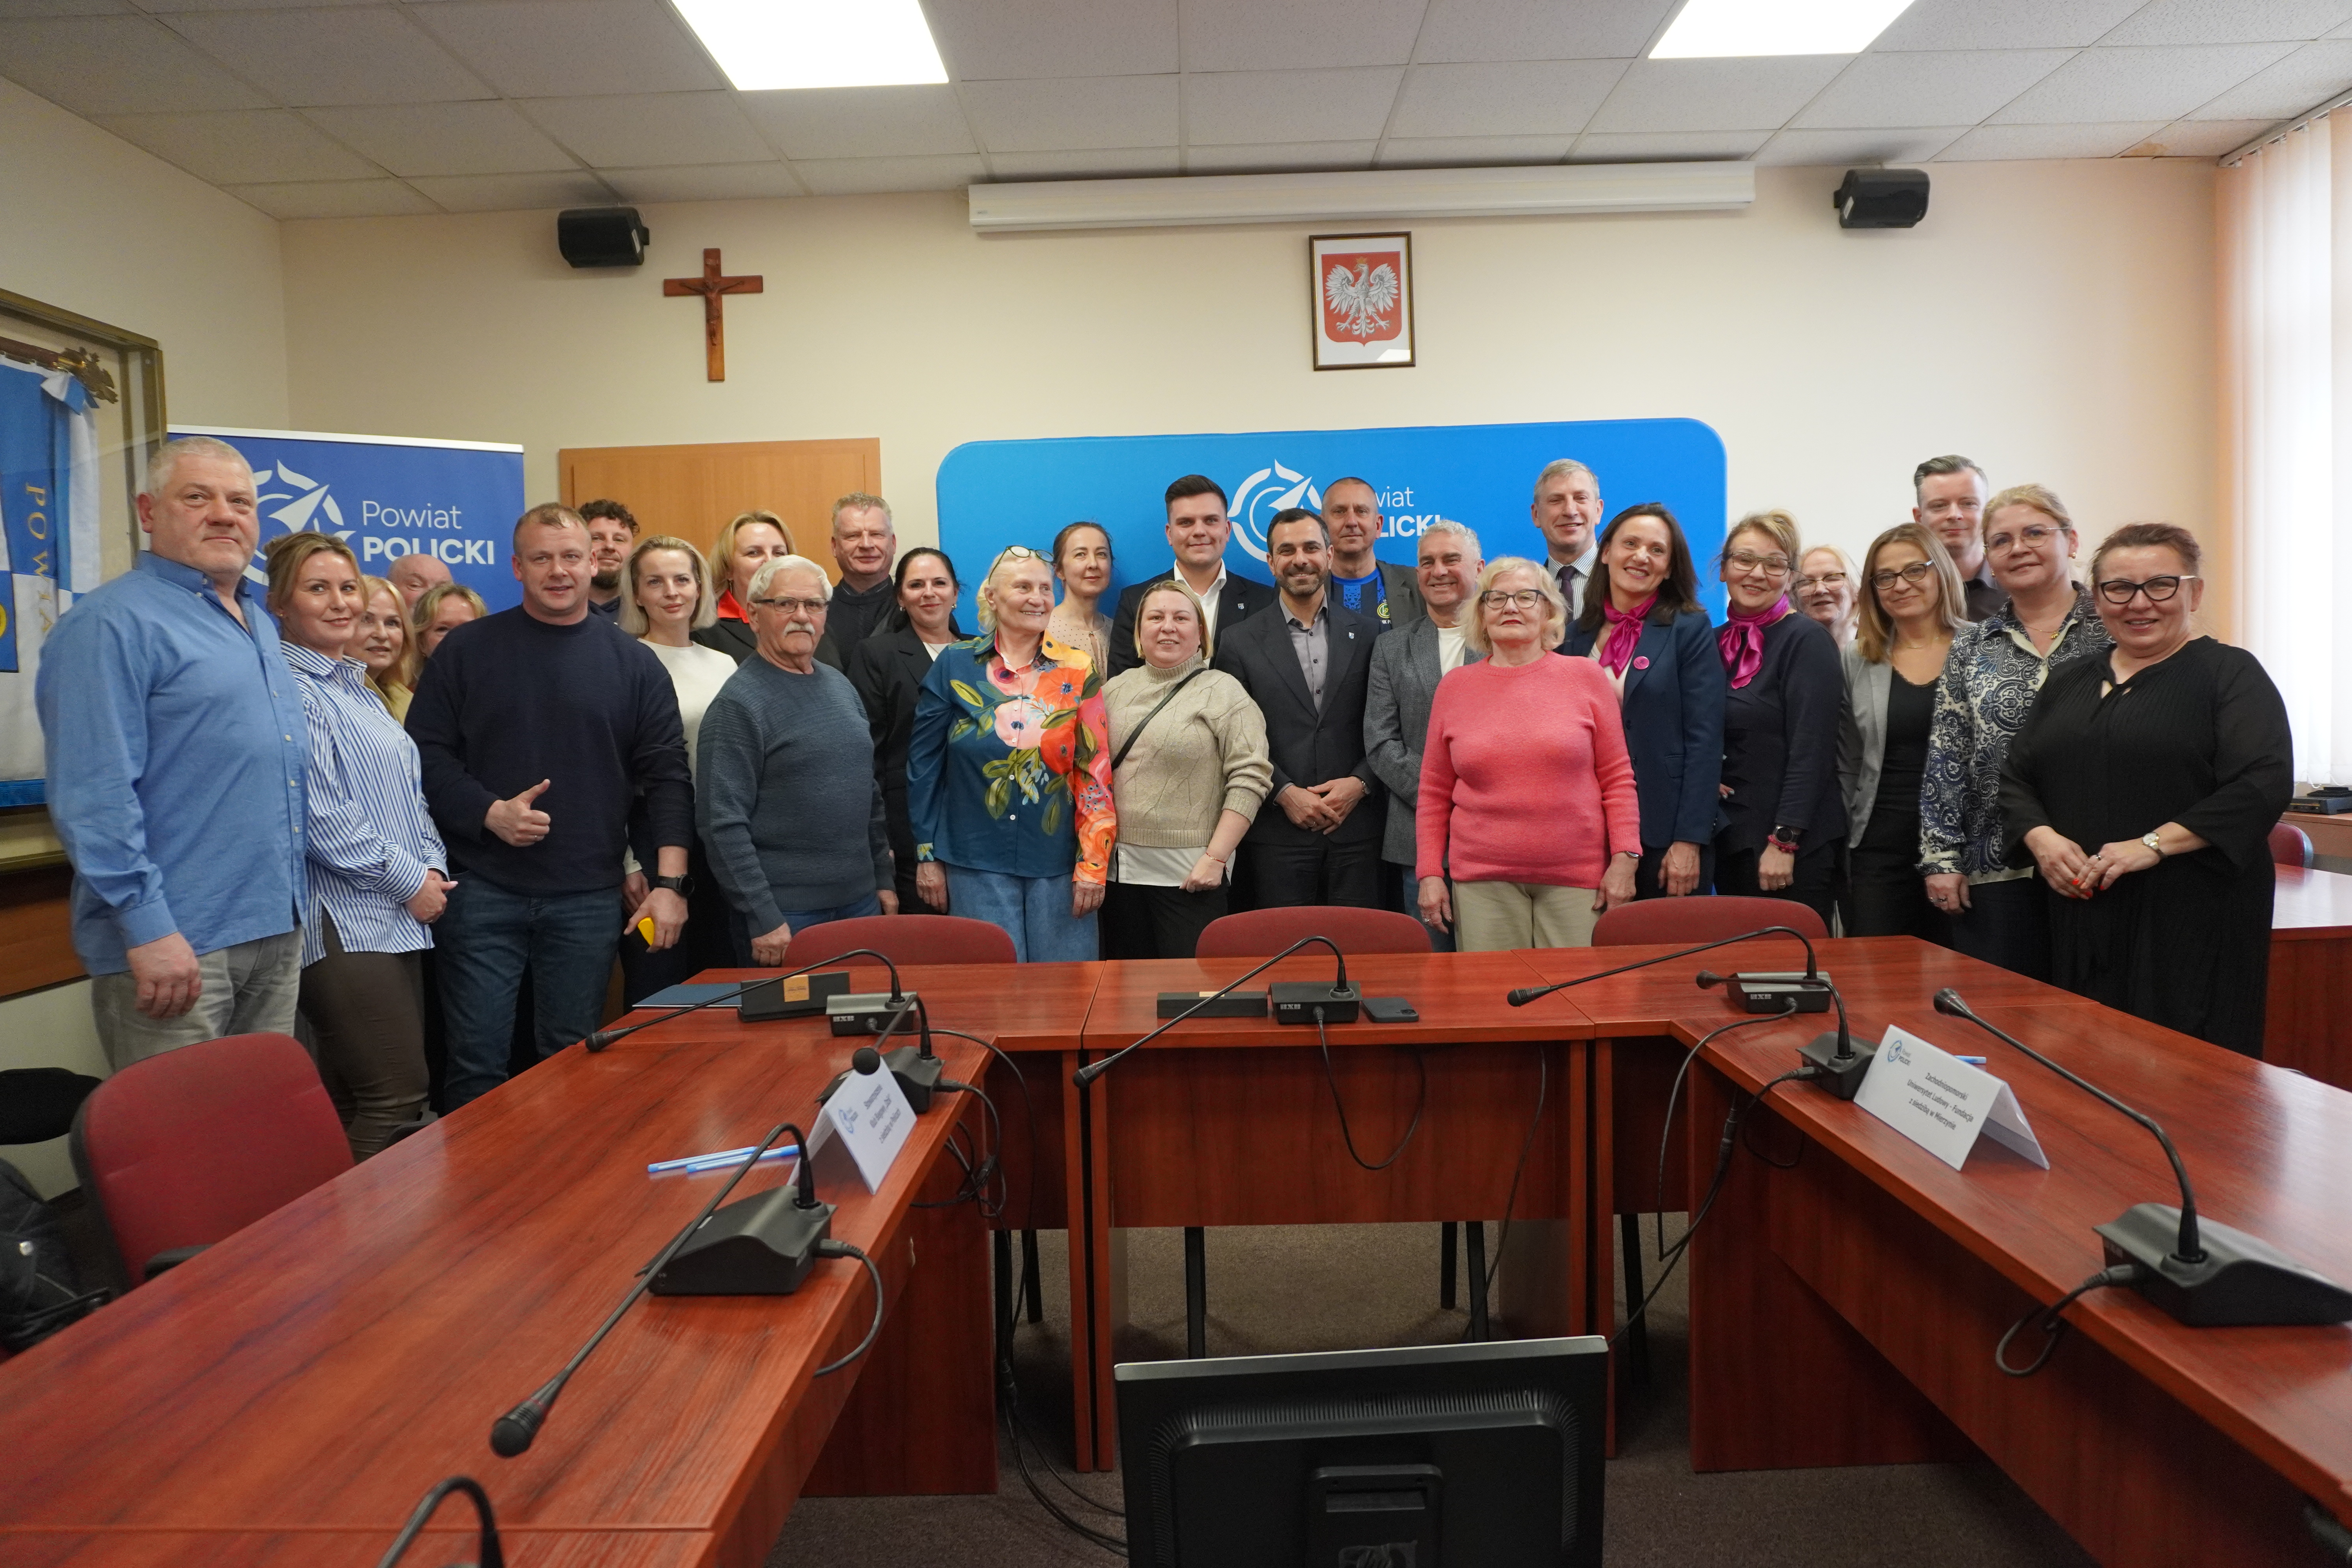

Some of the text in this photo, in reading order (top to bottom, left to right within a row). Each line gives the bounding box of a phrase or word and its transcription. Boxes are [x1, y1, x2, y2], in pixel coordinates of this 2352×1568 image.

[1375, 486, 1414, 507] iat
[362, 501, 462, 529] Powiat
[25, 482, 53, 632] POWIA
[1907, 1079, 1933, 1098] Uniwersytet
[1932, 1093, 1949, 1109] Ludowy
[1951, 1105, 1974, 1123] Fundacja
[1925, 1073, 1969, 1101] Zachodniopomorski
[1935, 1112, 1956, 1130] Mierzynie
